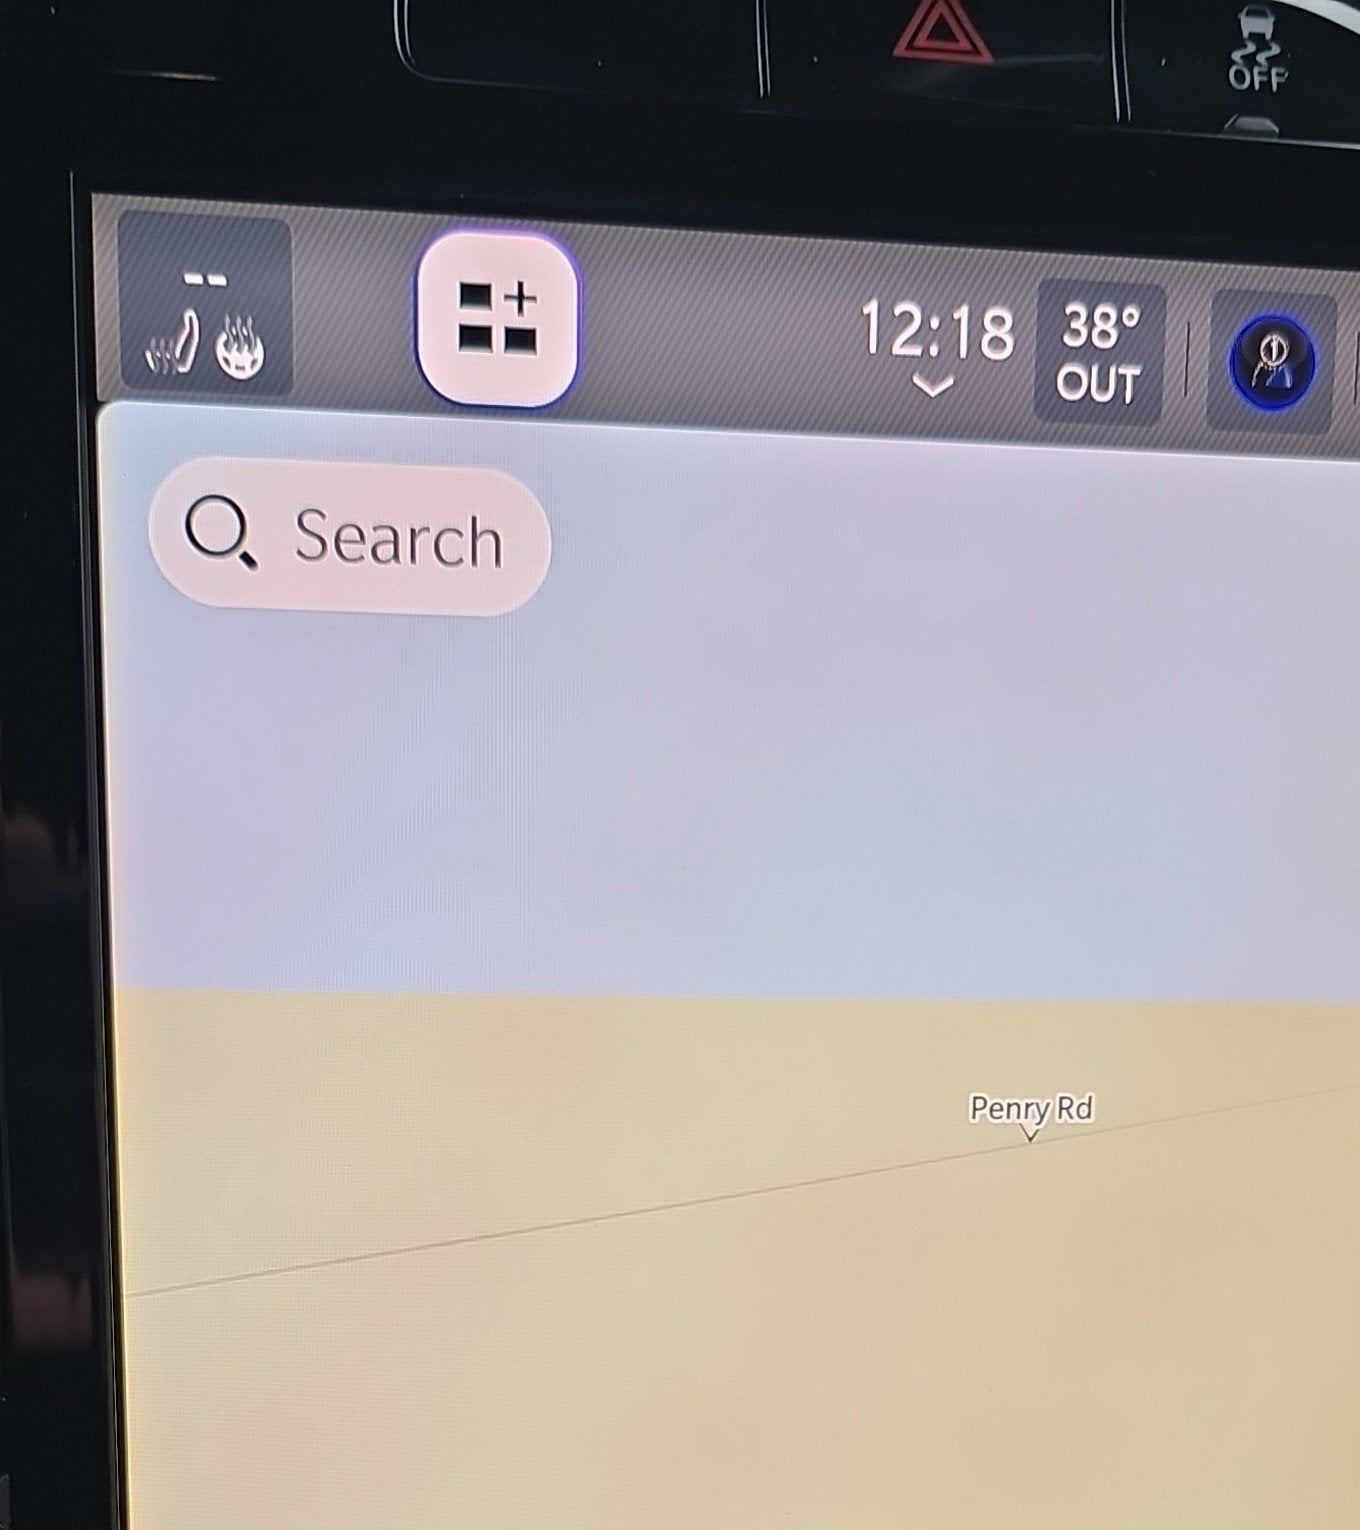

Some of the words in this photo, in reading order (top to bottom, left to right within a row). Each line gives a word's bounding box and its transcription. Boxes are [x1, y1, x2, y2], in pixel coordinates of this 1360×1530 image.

[1228, 63, 1290, 93] OFF
[861, 298, 1016, 361] 12:18
[1055, 359, 1142, 405] OUT
[295, 507, 504, 570] Search
[971, 1095, 1051, 1126] Penry
[1057, 1095, 1094, 1121] Rd
